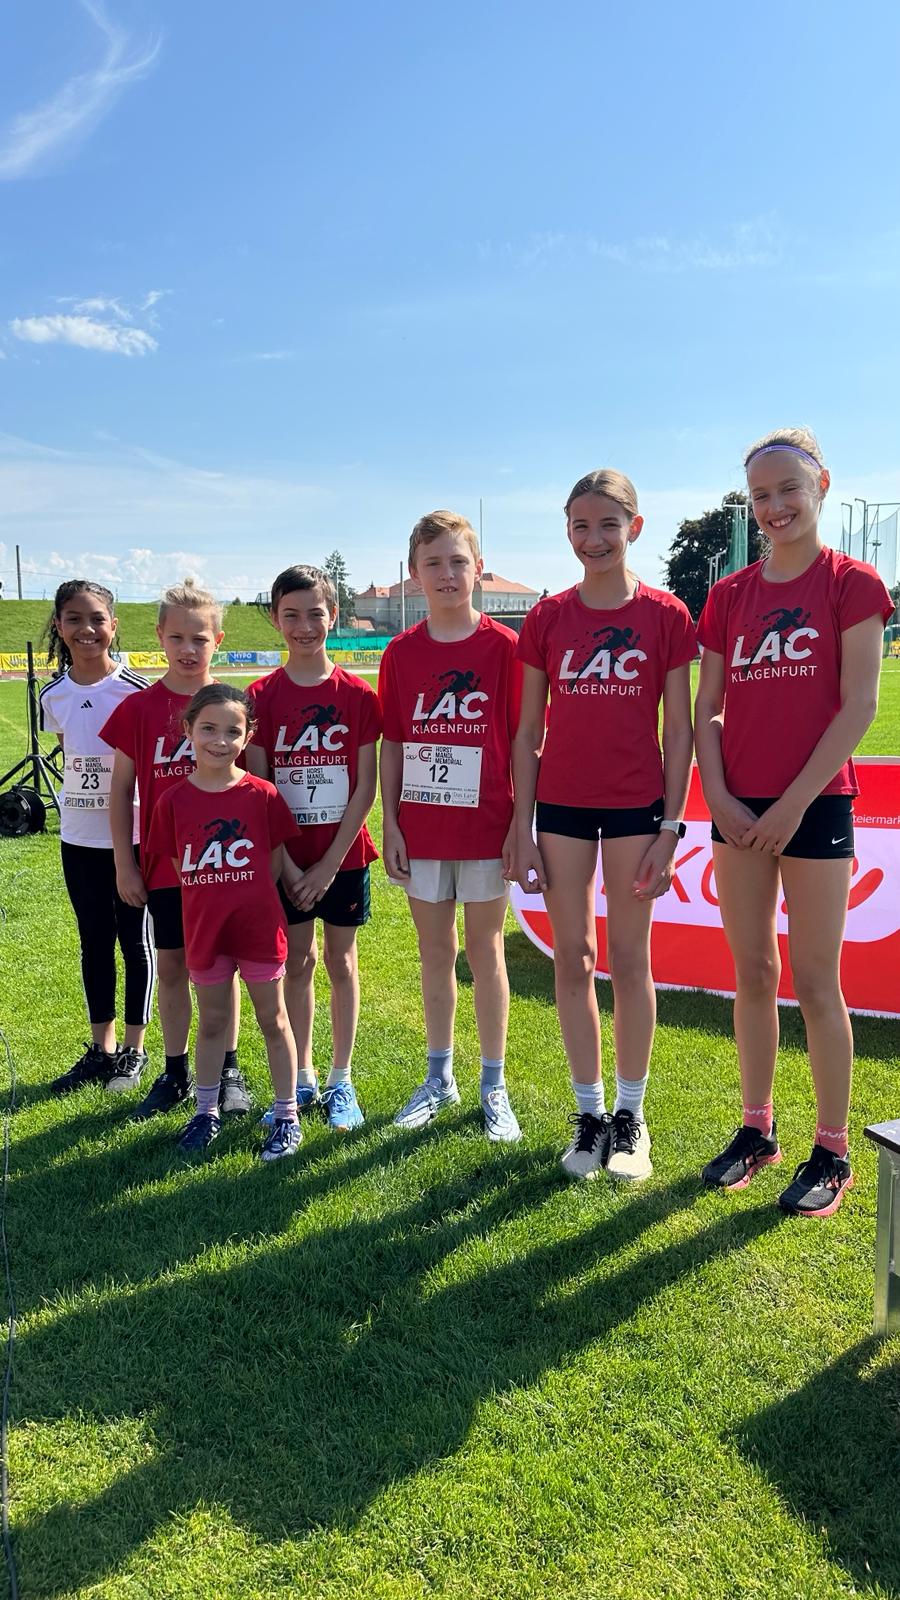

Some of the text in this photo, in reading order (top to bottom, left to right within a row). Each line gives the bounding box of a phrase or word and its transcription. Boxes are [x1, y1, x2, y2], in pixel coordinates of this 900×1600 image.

[730, 627, 820, 668] LAC
[558, 649, 648, 681] LAC
[731, 665, 818, 683] KLAGENFURT
[558, 683, 643, 697] KLAGENFURT
[412, 691, 489, 721] LAC
[274, 724, 350, 752] LAC
[412, 724, 488, 735] KLAGENFURT
[153, 736, 197, 765] LA
[274, 755, 348, 766] KLAGENFURT
[435, 758, 463, 766] MEMORIAL
[81, 773, 100, 790] 23
[429, 764, 449, 784] 12
[306, 785, 317, 804] 7
[403, 789, 441, 803] GRAZ
[181, 838, 255, 873] LAC
[181, 871, 255, 887] KLAGENFURT
